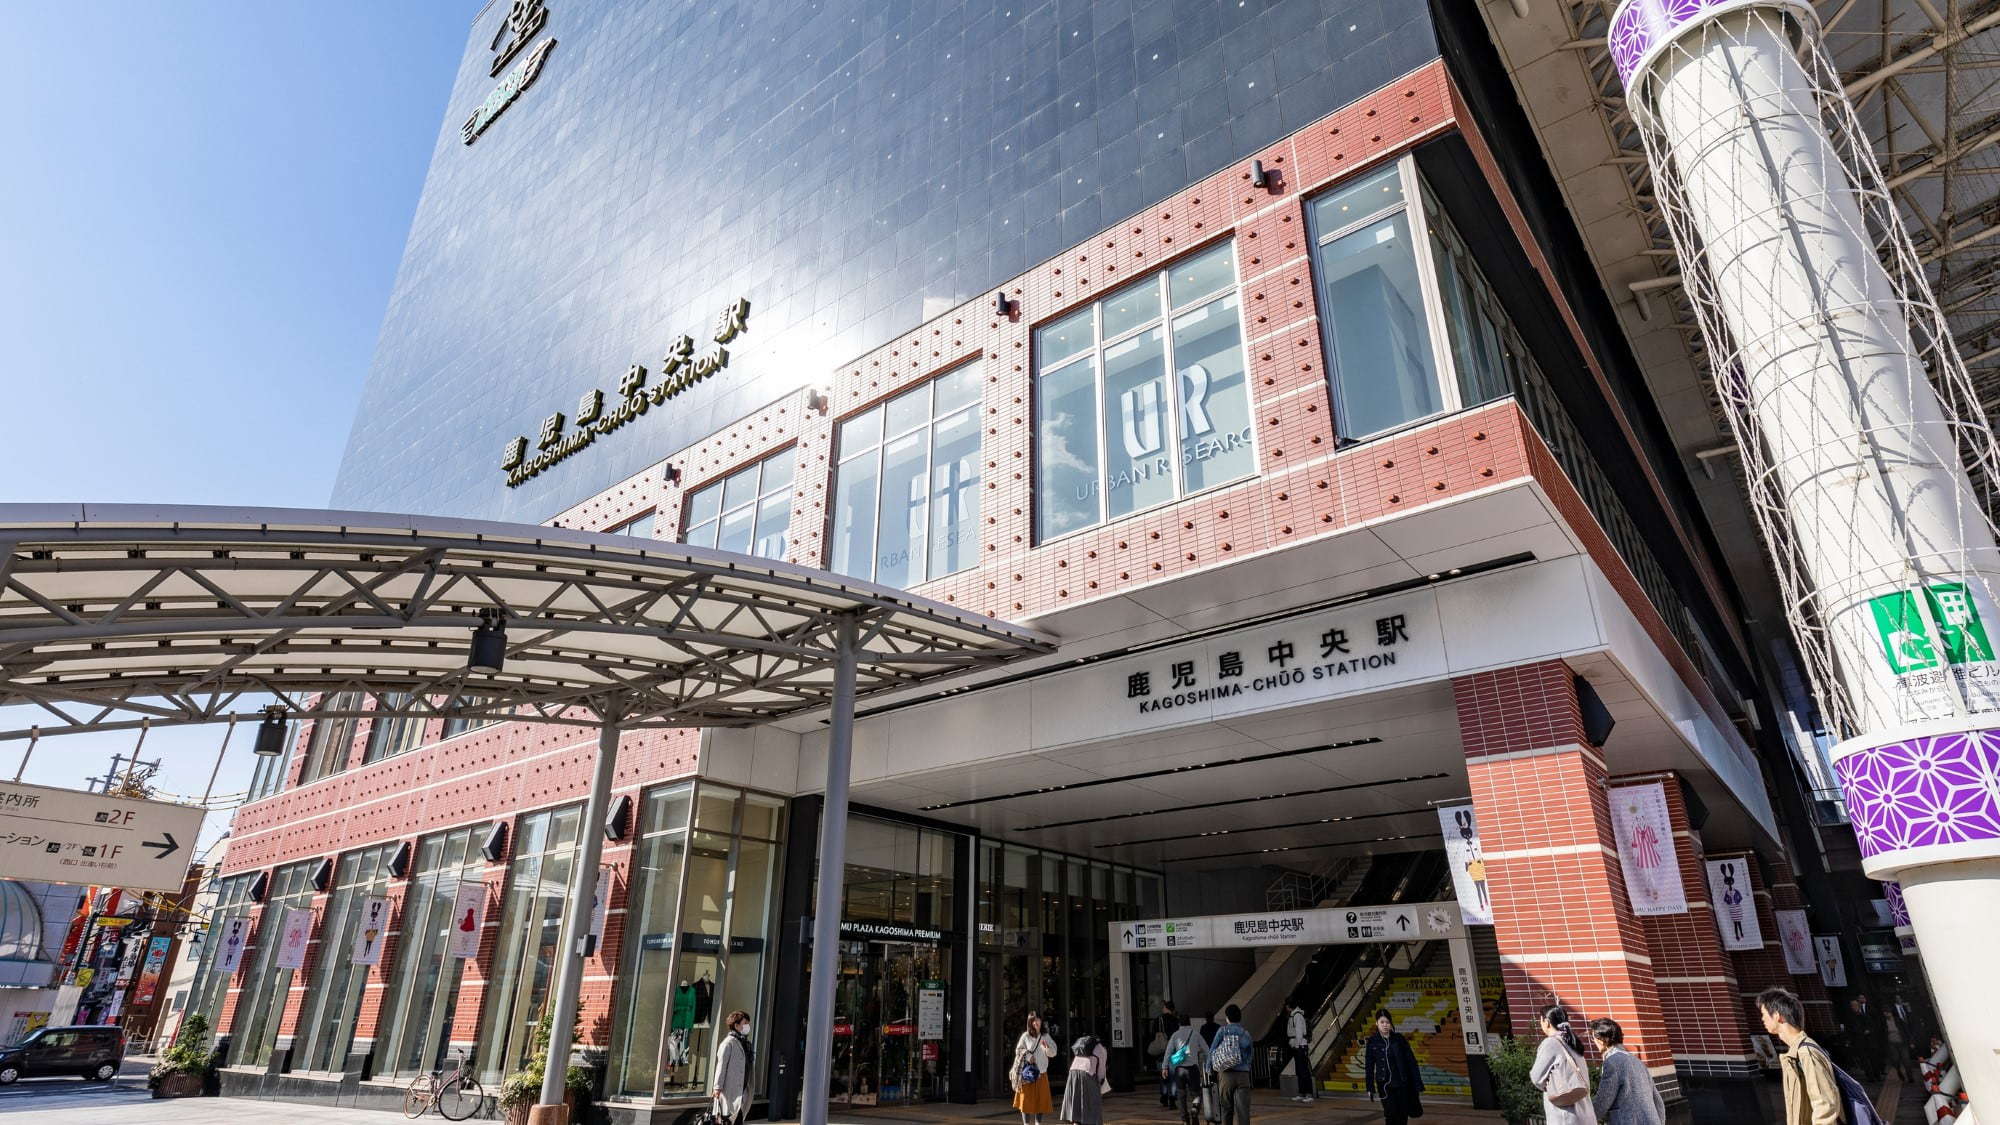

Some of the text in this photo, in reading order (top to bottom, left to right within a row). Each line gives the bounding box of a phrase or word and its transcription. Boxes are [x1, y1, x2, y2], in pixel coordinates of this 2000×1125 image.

[501, 297, 750, 471] 鹿児島中央駅
[647, 347, 728, 405] STATION
[1121, 364, 1211, 459] UR
[1076, 425, 1252, 500] URBAN RSEARC
[1127, 614, 1409, 698] 鹿児島中央駅
[1139, 652, 1396, 713] KAGOSHIMA-CHŪŌ STATION
[108, 809, 136, 825] 2F
[100, 844, 124, 859] 1F
[853, 922, 874, 933] PLAZA
[875, 924, 914, 937] KAGOSHIMA
[915, 929, 941, 939] PREMIUM
[1234, 917, 1305, 934] 鹿児島中央駅
[1458, 968, 1474, 1024] 鹿児島中央駅
